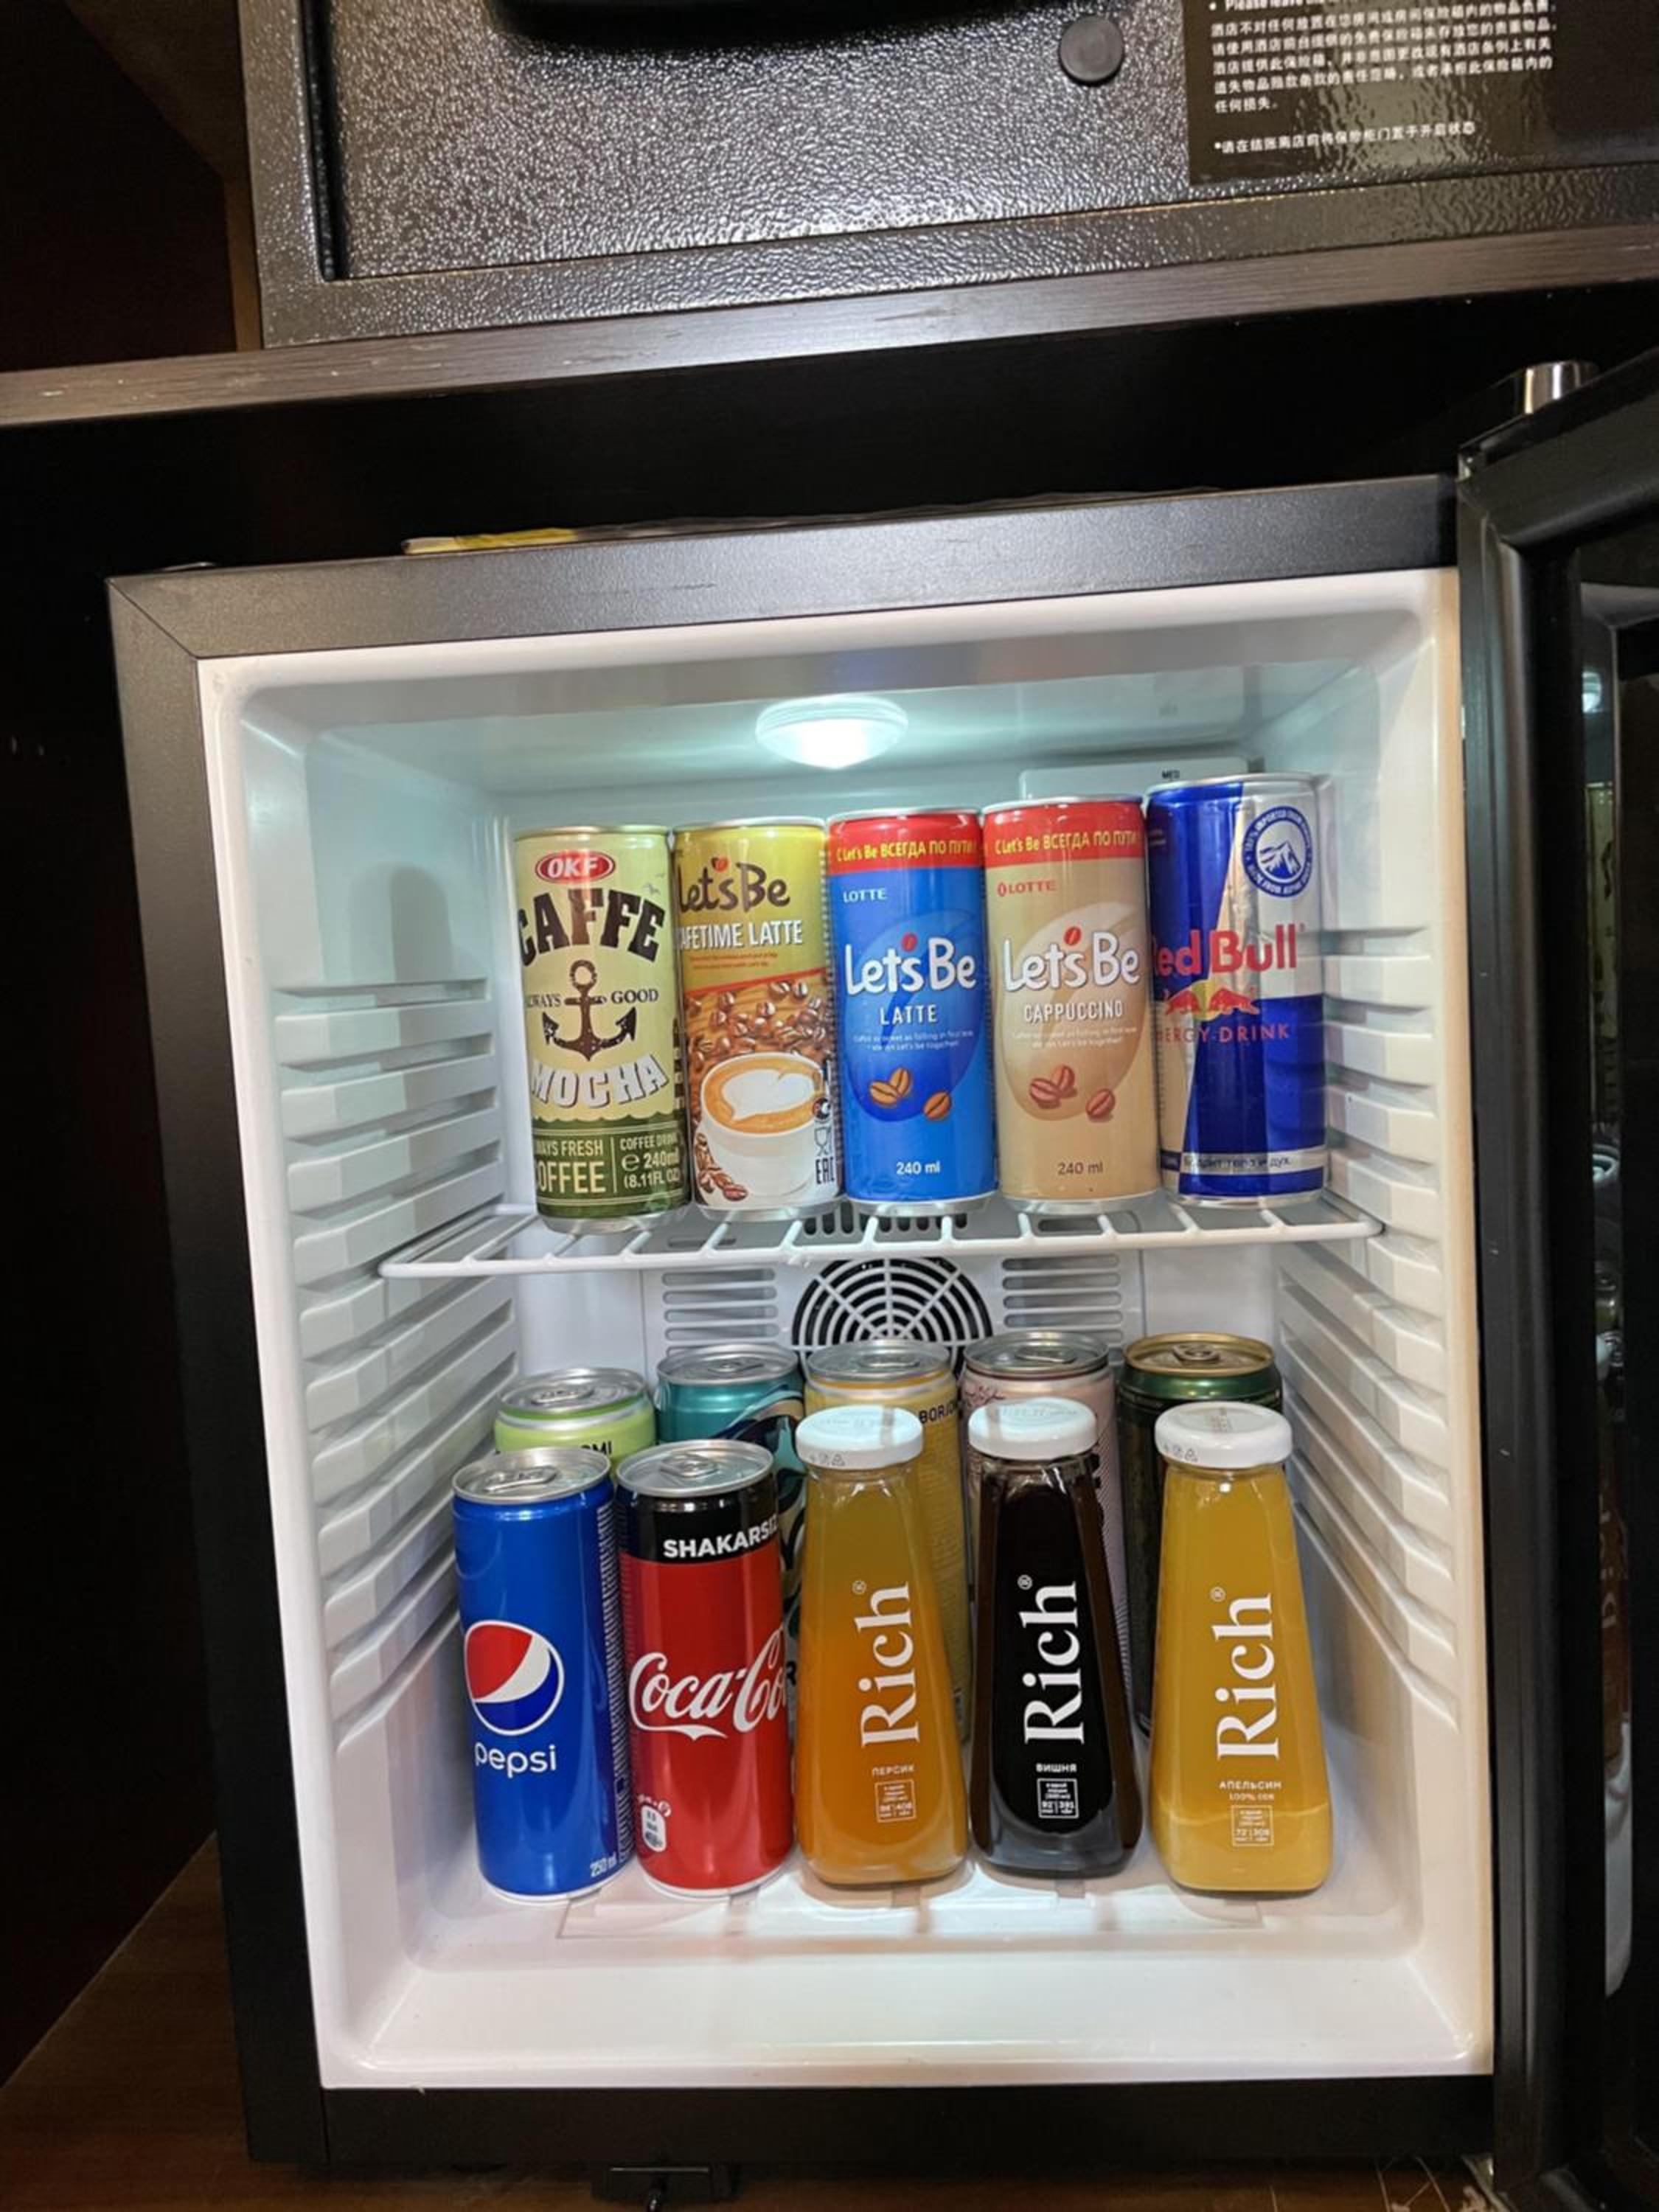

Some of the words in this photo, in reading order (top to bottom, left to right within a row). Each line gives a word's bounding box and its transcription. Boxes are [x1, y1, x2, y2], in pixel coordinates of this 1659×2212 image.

[880, 841, 925, 858] ВСЕГДА
[929, 841, 946, 855] ПО
[1043, 832, 1089, 849] ВСЕГДА
[1093, 831, 1110, 846] ПО
[546, 857, 599, 878] OKF
[736, 862, 791, 913] Be
[843, 888, 888, 903] LOTTE
[1008, 880, 1056, 894] LOTTE
[518, 888, 665, 967] CAFFE
[748, 919, 803, 945] LATTE
[1092, 931, 1141, 987] Be
[1155, 928, 1202, 976] ed
[1210, 924, 1297, 975] Bull
[928, 937, 977, 990] Be
[611, 989, 659, 1004] GOOD
[880, 1004, 937, 1025] LATTE
[1023, 1000, 1123, 1023] CAPPUCCINO
[1219, 1023, 1290, 1043] DRINK
[532, 1054, 669, 1108] MOCHA
[560, 1139, 604, 1157] FRESH
[620, 1135, 655, 1151] COFFEE
[538, 1161, 606, 1194] OFFEE
[896, 1161, 921, 1175] 240
[925, 1160, 940, 1174] ml
[1057, 1162, 1084, 1175] 240
[1088, 1161, 1103, 1174] ml
[854, 1580, 920, 1748] Rich
[1018, 1580, 1085, 1745] Rich
[1211, 1593, 1280, 1761] Rich
[474, 1742, 557, 1778] pepsi
[1036, 1763, 1077, 1773] ВИШНЯ
[1219, 1781, 1281, 1790] АПЕЛЬСИН
